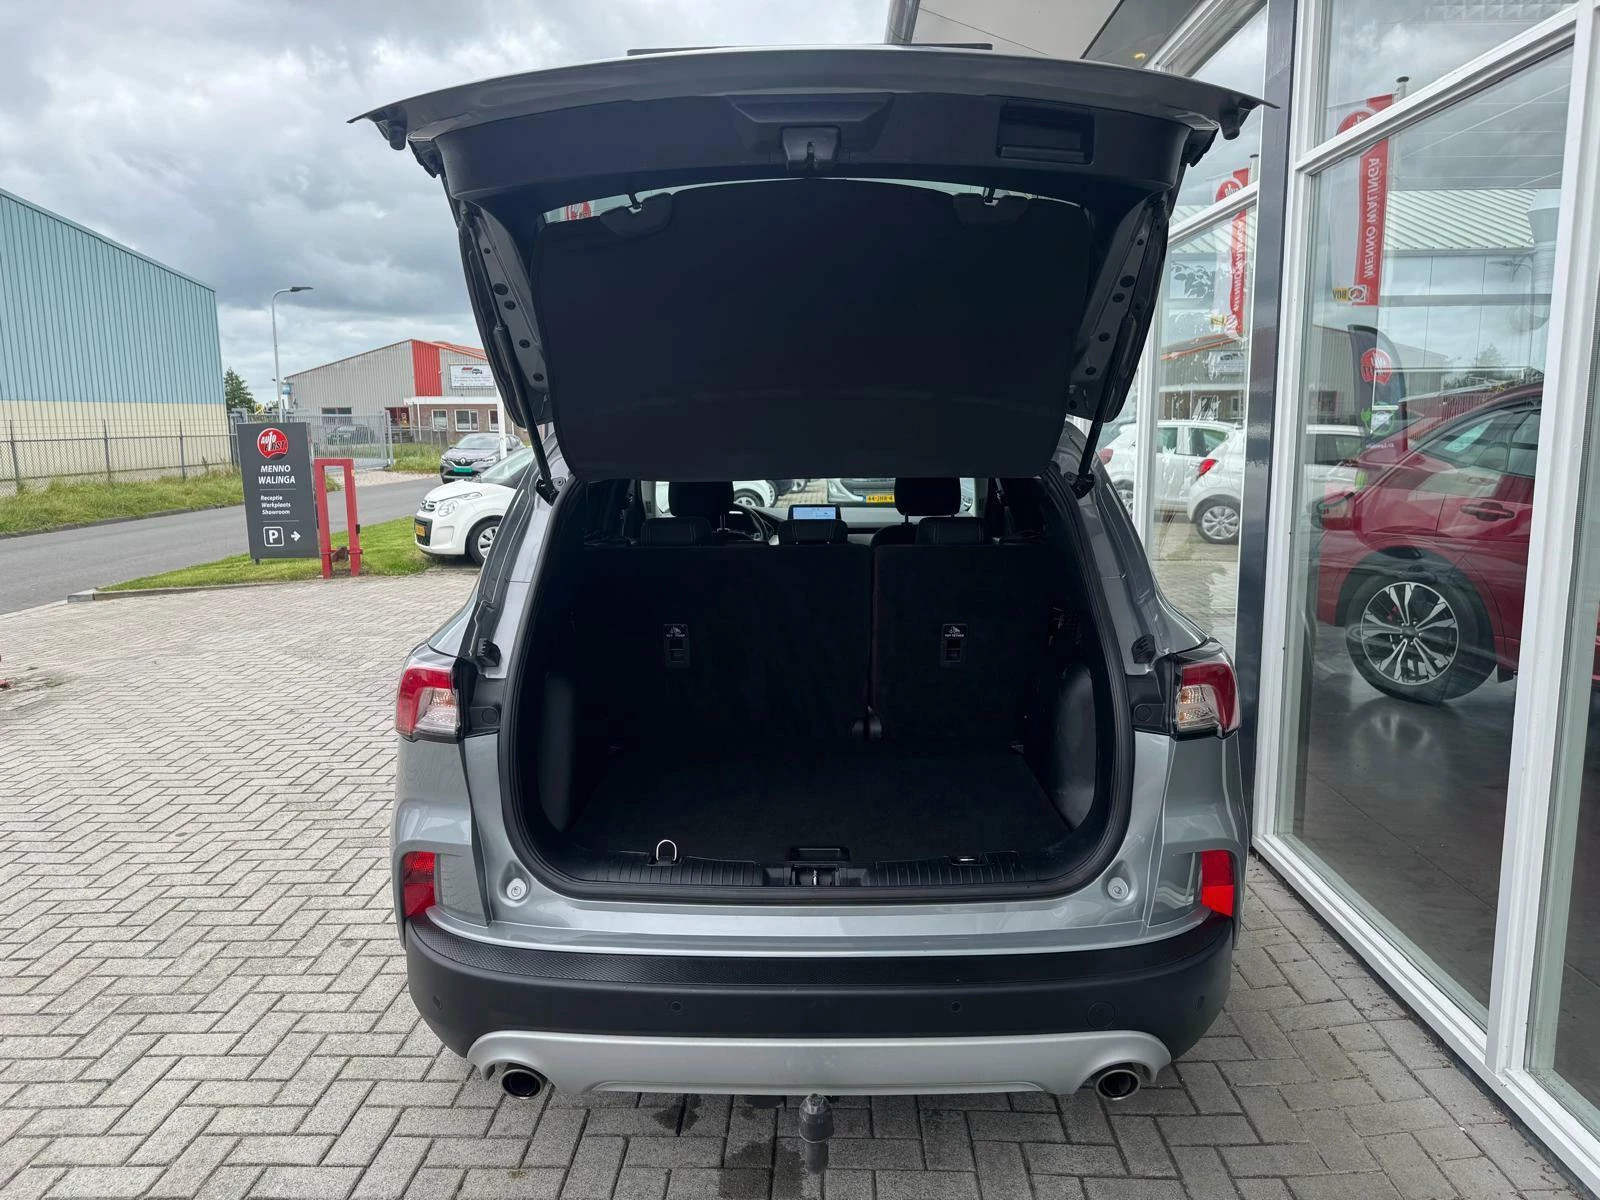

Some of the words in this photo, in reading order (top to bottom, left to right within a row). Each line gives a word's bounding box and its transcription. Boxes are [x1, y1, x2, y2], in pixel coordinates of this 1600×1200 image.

[260, 431, 277, 445] AUTO
[260, 464, 291, 473] MENNO
[258, 475, 296, 485] WALINGA
[268, 529, 279, 544] P
